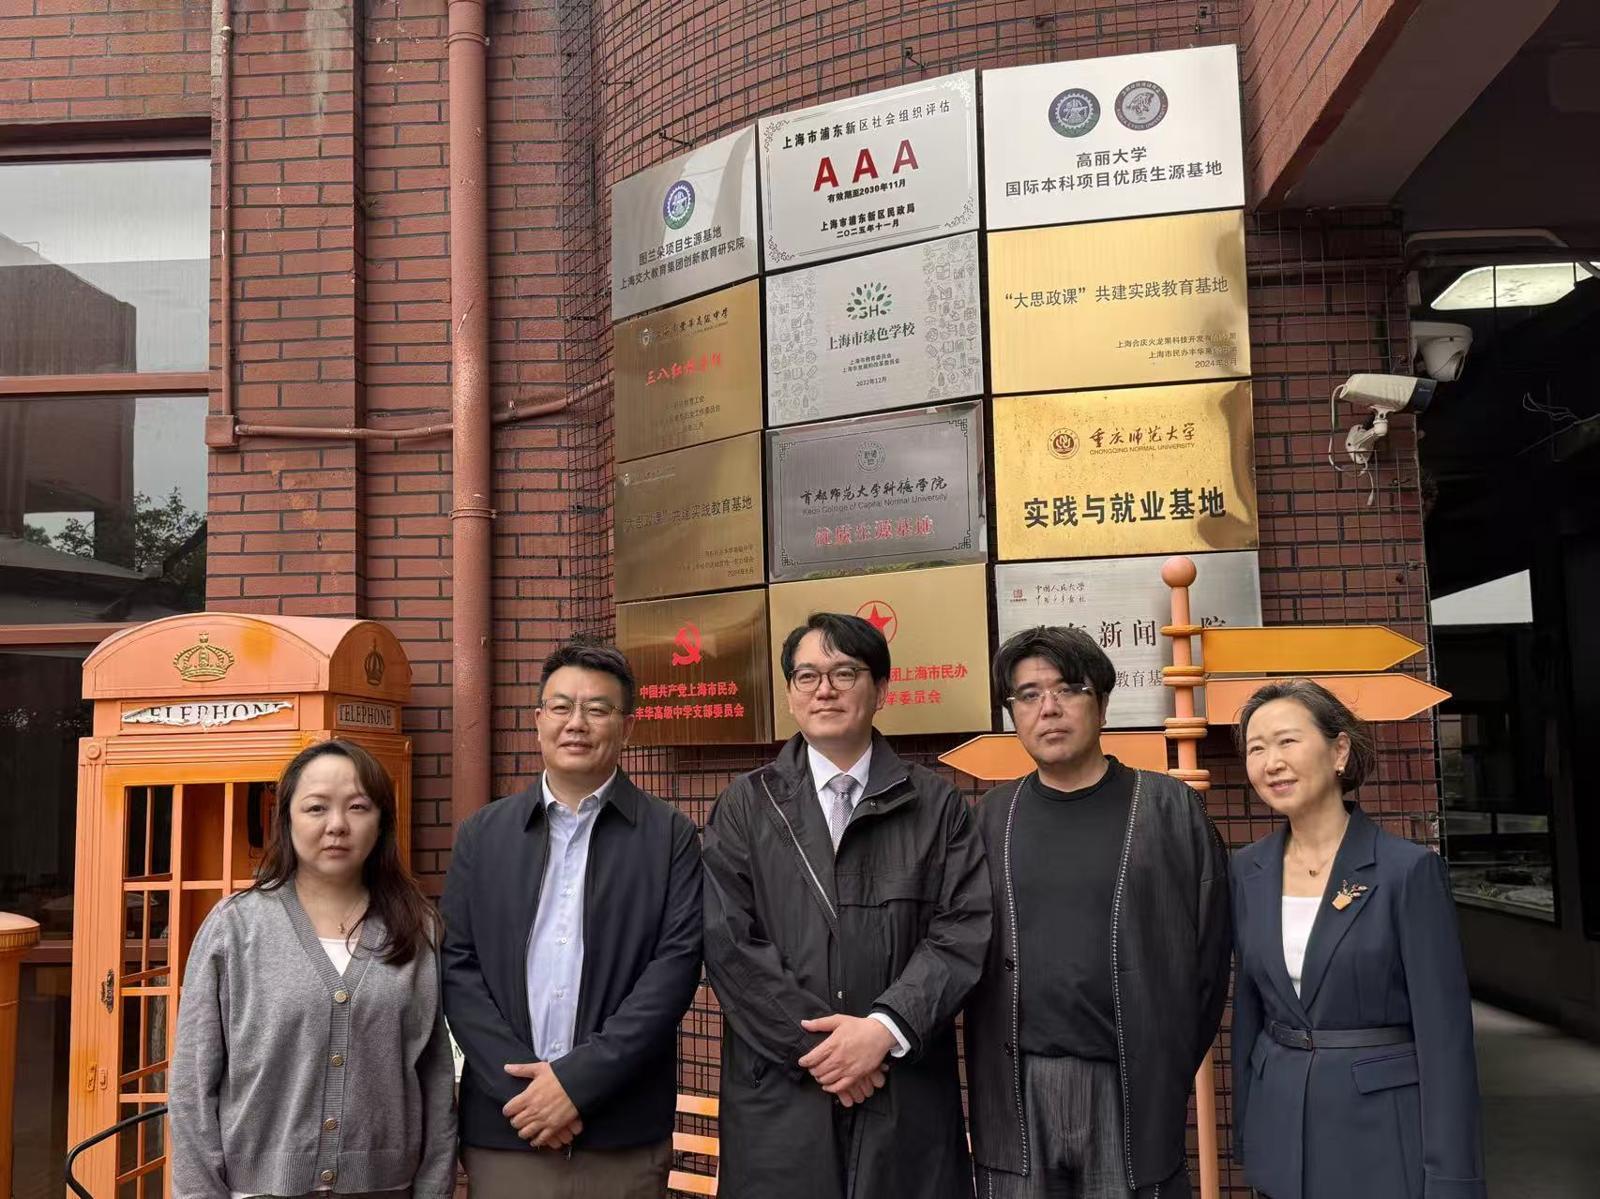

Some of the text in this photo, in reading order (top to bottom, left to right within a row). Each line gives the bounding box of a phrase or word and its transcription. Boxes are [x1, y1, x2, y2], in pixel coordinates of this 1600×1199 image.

[782, 99, 951, 149] 上海市浦东新区社会组织评估
[1076, 146, 1147, 168] 高丽大学
[827, 178, 906, 203] 有效期至2030年11月
[1005, 159, 1223, 197] 国际本科项目优质生源基地
[820, 202, 916, 232] 上海市浦东新区民政局
[620, 236, 746, 290] 上海交大教育集团创新教育研究院
[829, 321, 915, 350] 上海市绿色学校
[1089, 422, 1195, 448] 重庆师范大学
[1089, 443, 1195, 455] CHONGQING NORMAL UNIVERSITY
[800, 476, 948, 505] 首都师范大学科德学院
[1024, 486, 1227, 529] 实践与就业基地
[889, 663, 968, 683] 团上海市民办
[1115, 670, 1162, 689] 教育基
[639, 681, 739, 699] 中国共产党上海市民办
[886, 689, 943, 706] 学委员会
[124, 702, 287, 720] ELEPHON
[339, 704, 392, 726] TELEPHONE
